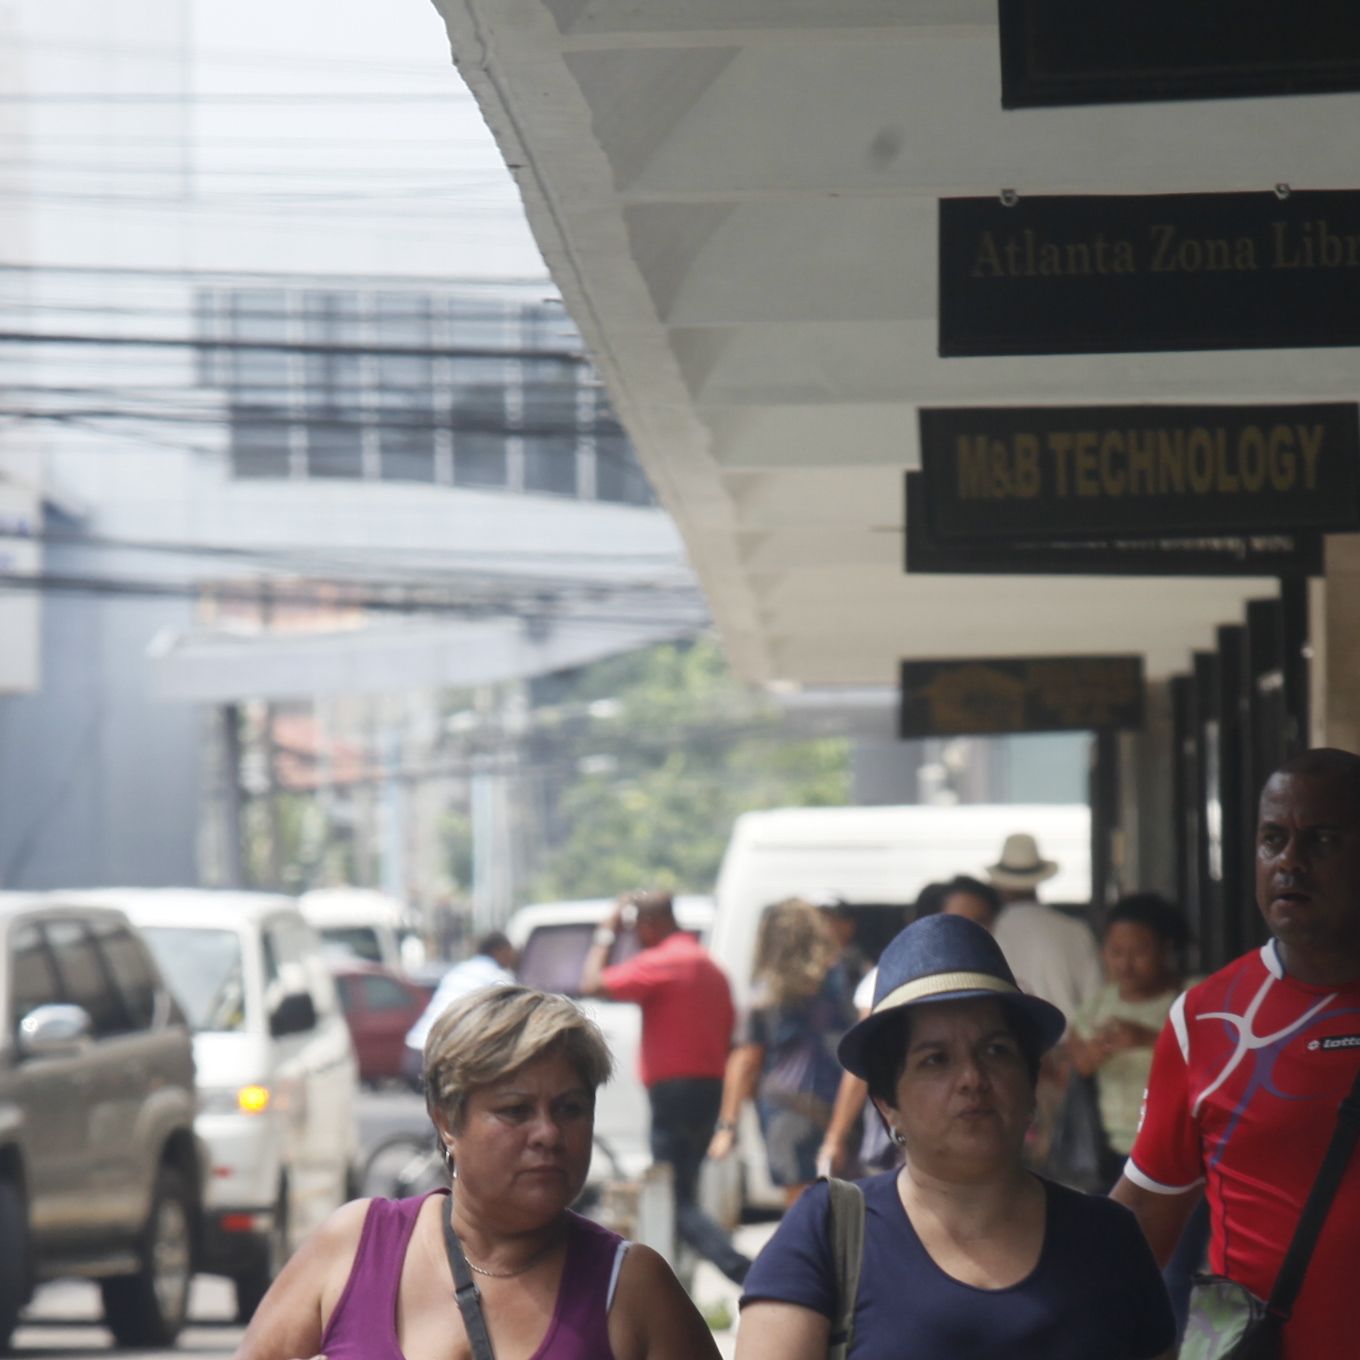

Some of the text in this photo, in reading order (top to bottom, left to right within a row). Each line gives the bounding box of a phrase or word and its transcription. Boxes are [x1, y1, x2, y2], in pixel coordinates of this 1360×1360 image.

[974, 229, 1134, 277] Atlanta
[1151, 223, 1255, 271] Zona
[959, 426, 1323, 498] M&B TECHNOLOGY
